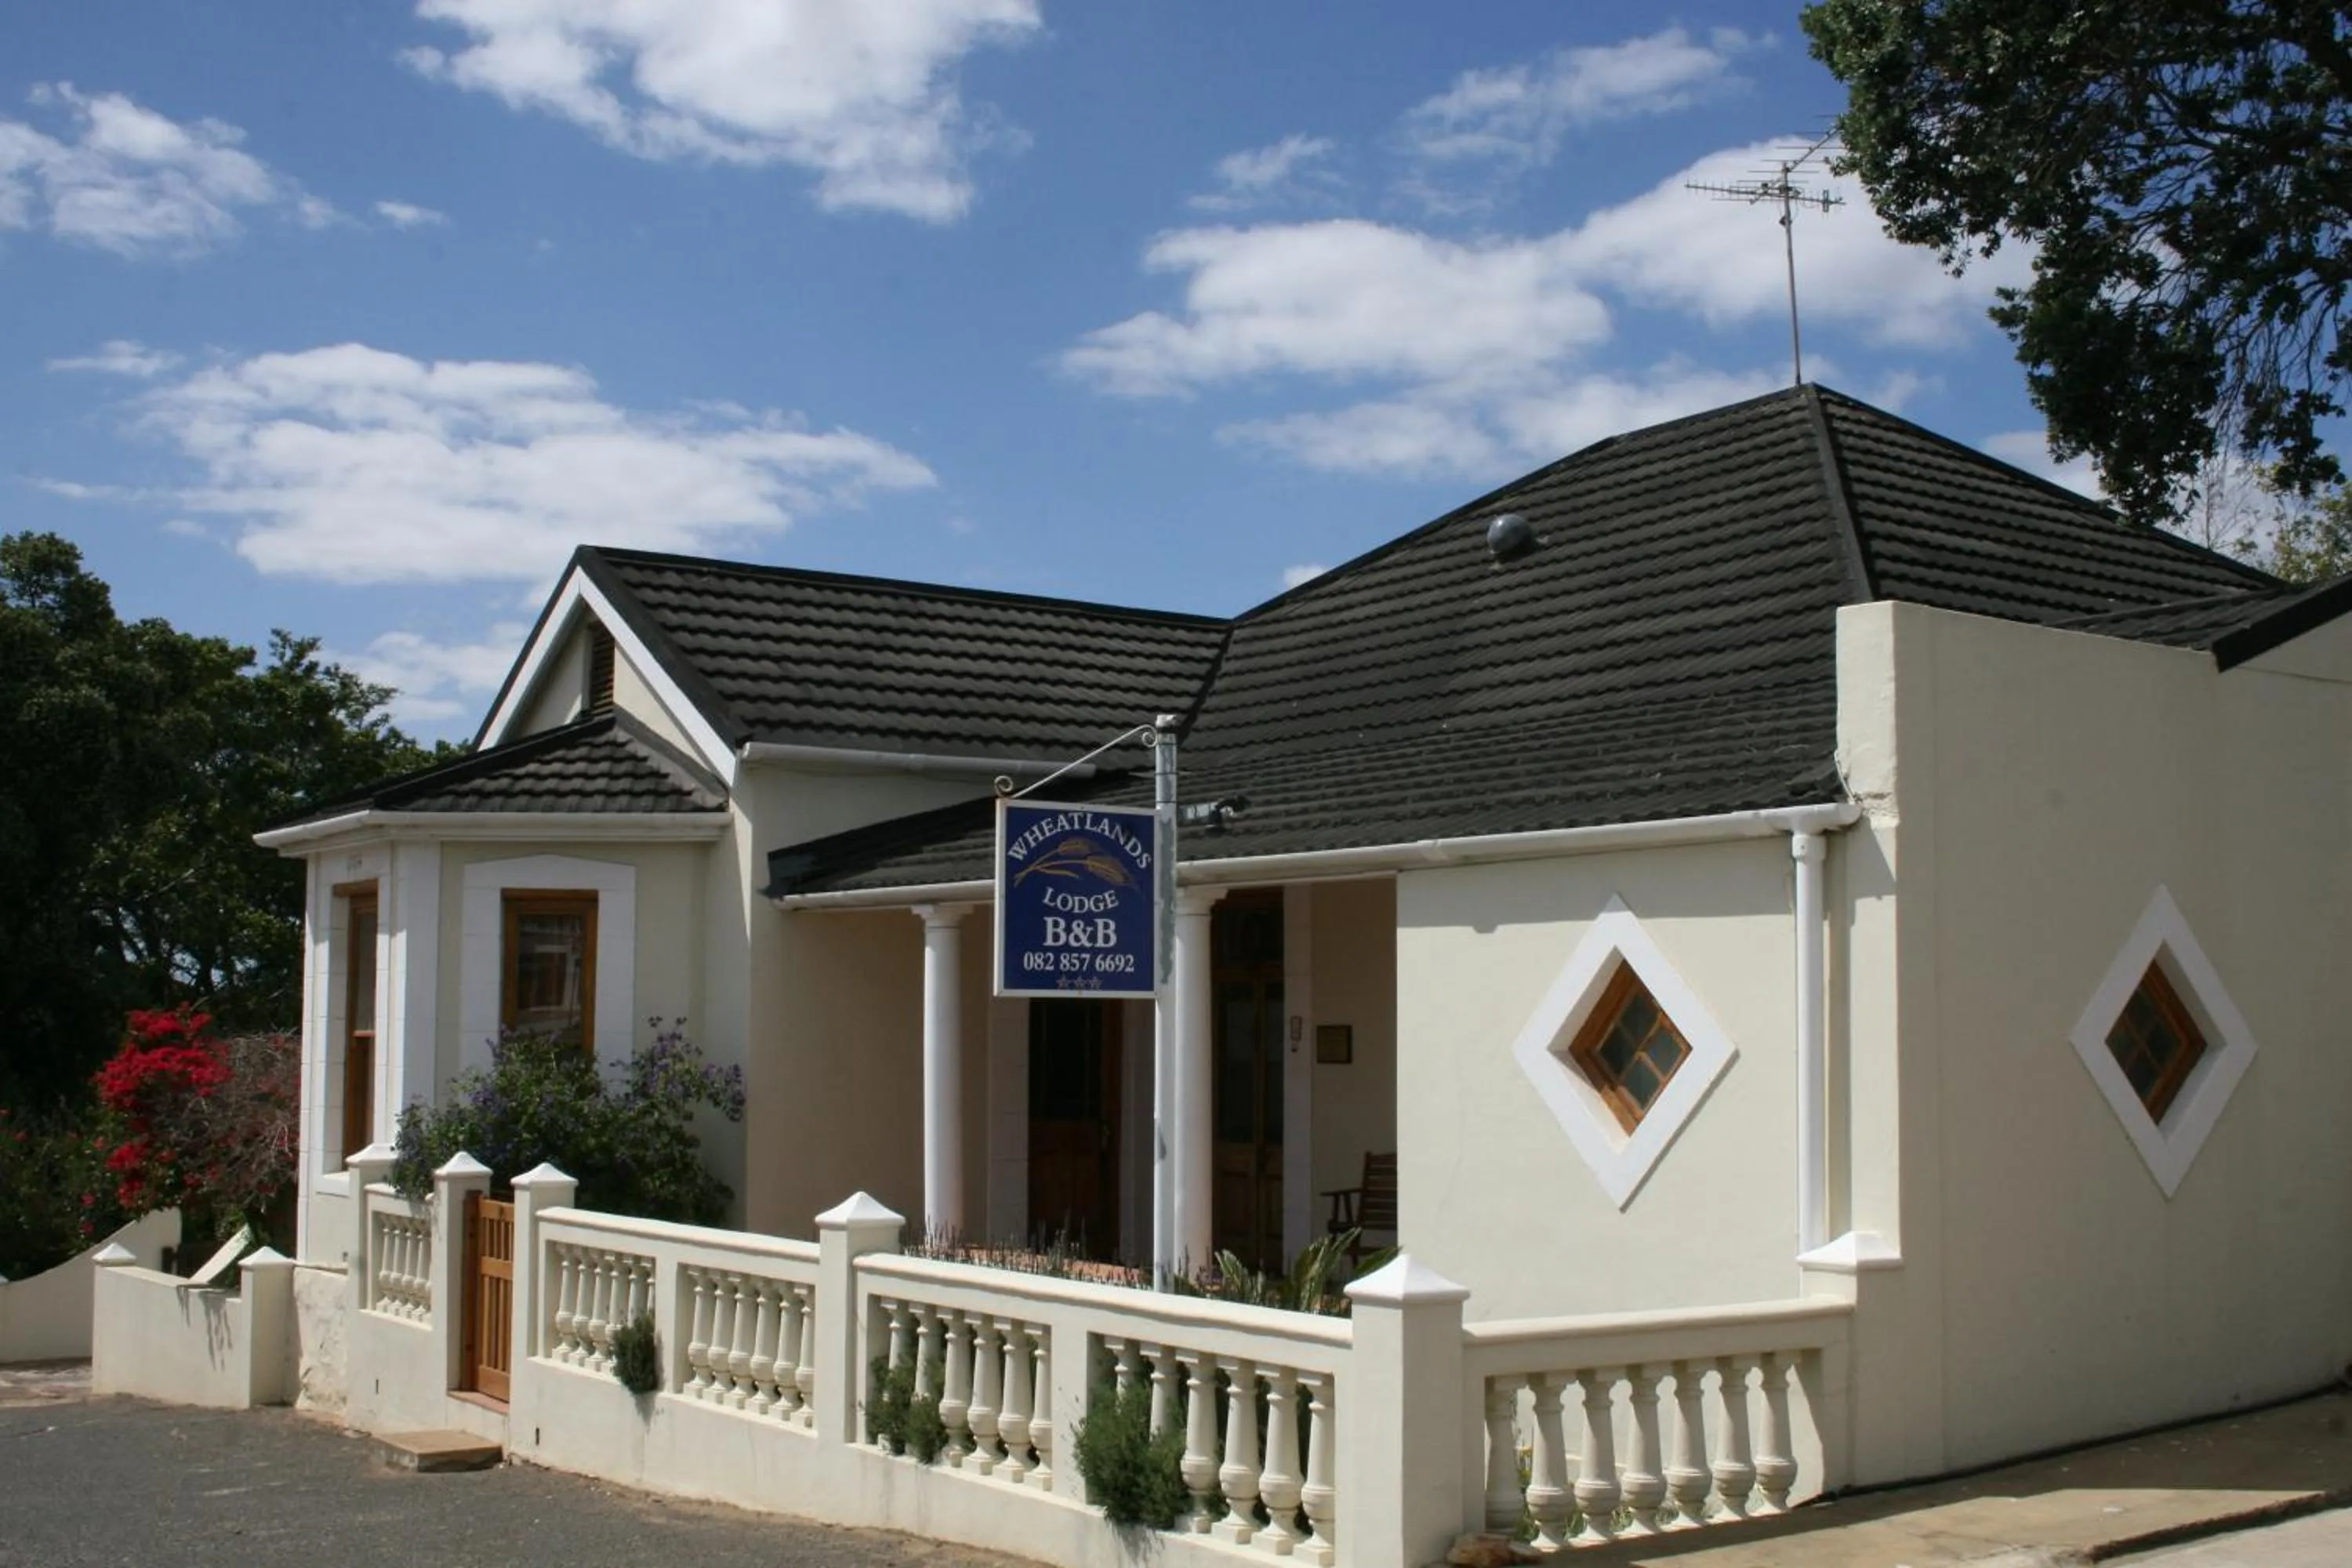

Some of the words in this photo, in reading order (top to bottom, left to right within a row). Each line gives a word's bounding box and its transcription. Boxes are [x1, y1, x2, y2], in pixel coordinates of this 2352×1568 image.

[1007, 811, 1152, 869] WHEATLANDS
[1043, 887, 1119, 913] LODGE
[1043, 916, 1117, 948] B&B
[1023, 952, 1054, 971] 082
[1059, 953, 1090, 971] 857
[1095, 953, 1134, 972] 6692
